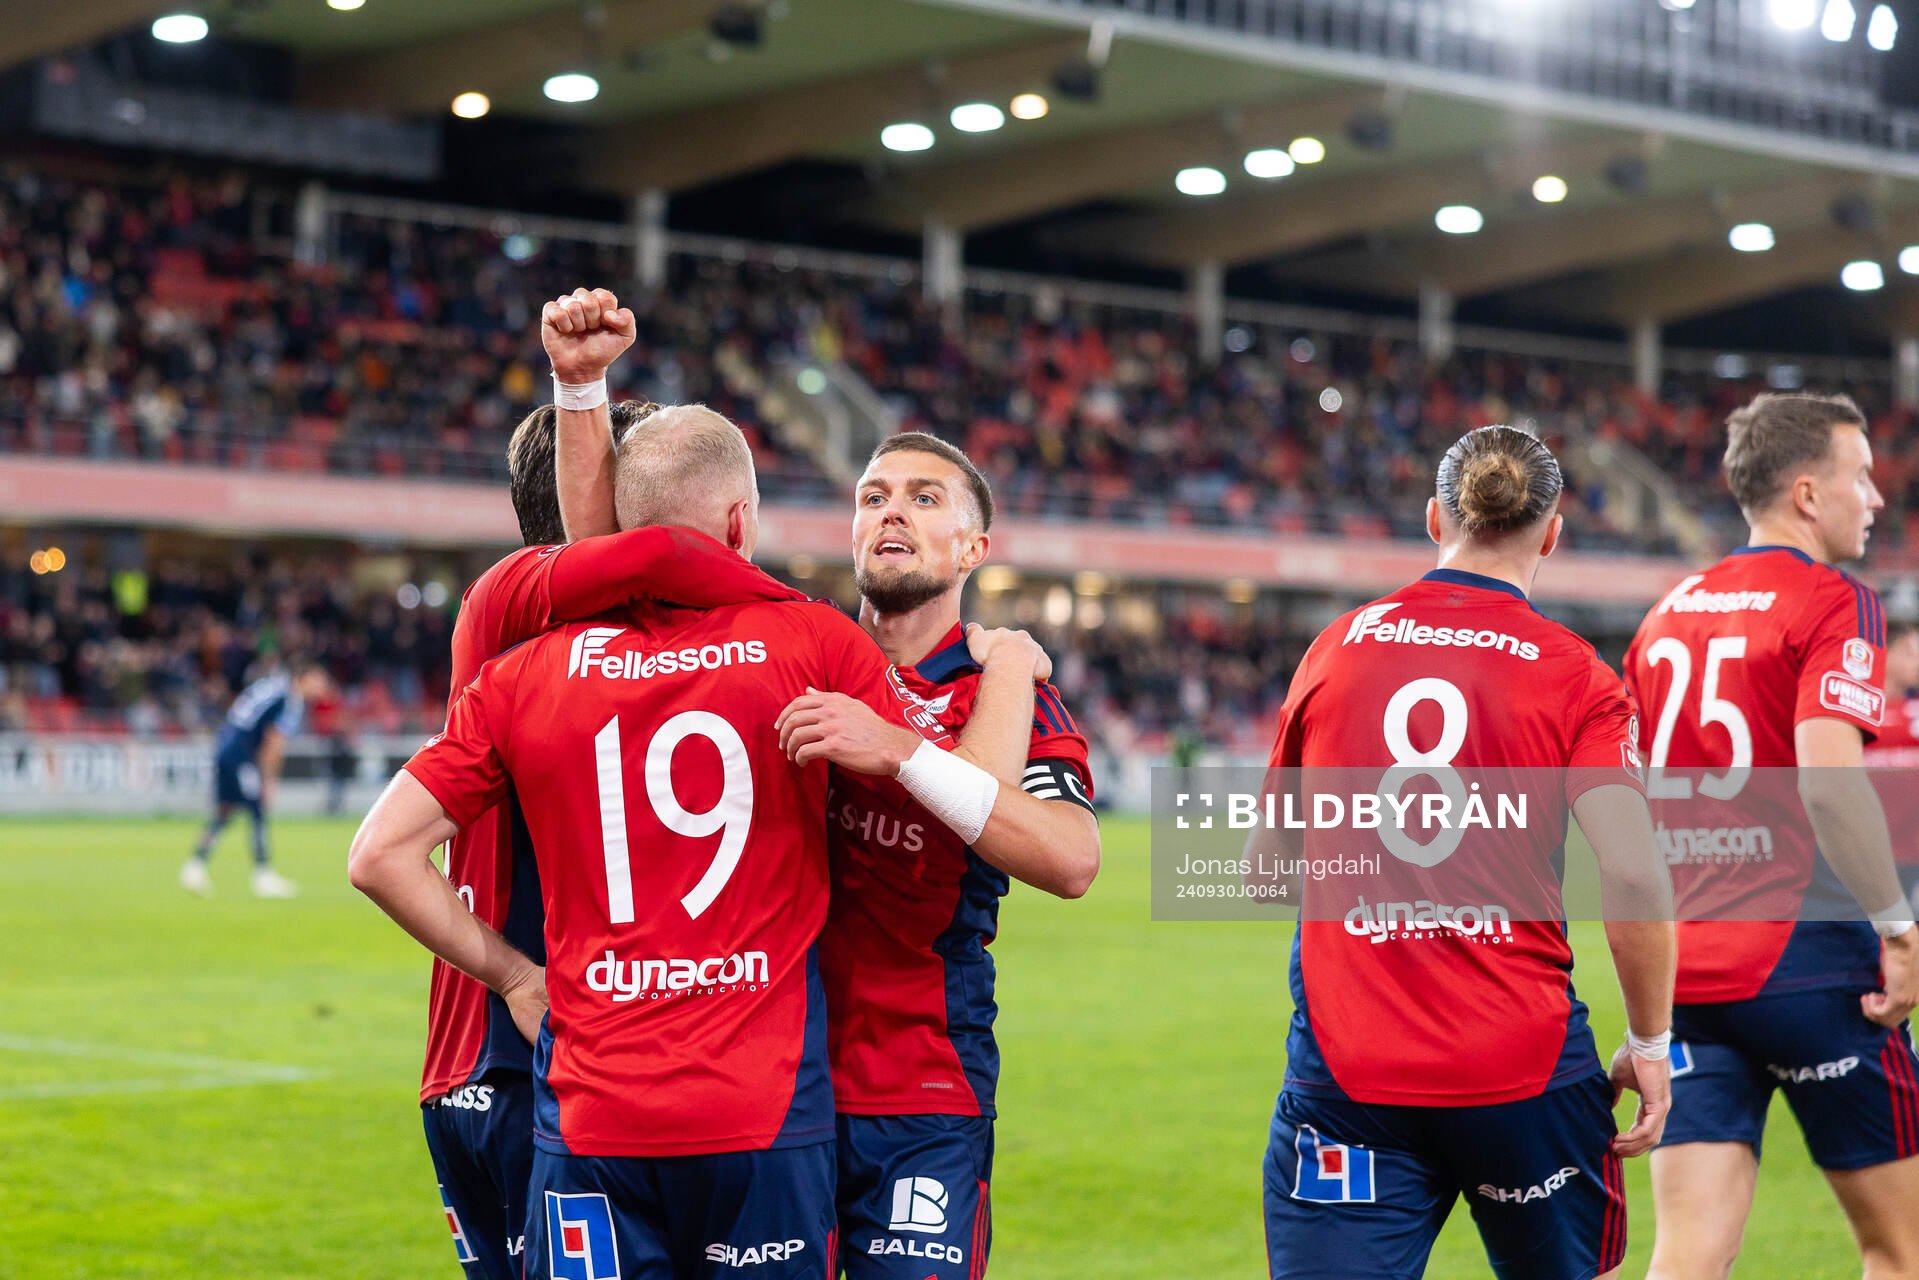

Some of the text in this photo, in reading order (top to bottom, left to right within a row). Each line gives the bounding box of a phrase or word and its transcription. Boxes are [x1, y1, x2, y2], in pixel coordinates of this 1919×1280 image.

[577, 636, 767, 680] Fellessons
[1350, 610, 1540, 661] Fellessons
[1646, 636, 1753, 801] 25
[1376, 677, 1469, 868] 8
[594, 710, 755, 924] 19
[1344, 895, 1512, 944] dynacon
[586, 950, 770, 1002] dynacon
[1478, 1166, 1581, 1204] SHARP
[705, 1239, 806, 1268] SHARP
[867, 1238, 963, 1264] BALCO
